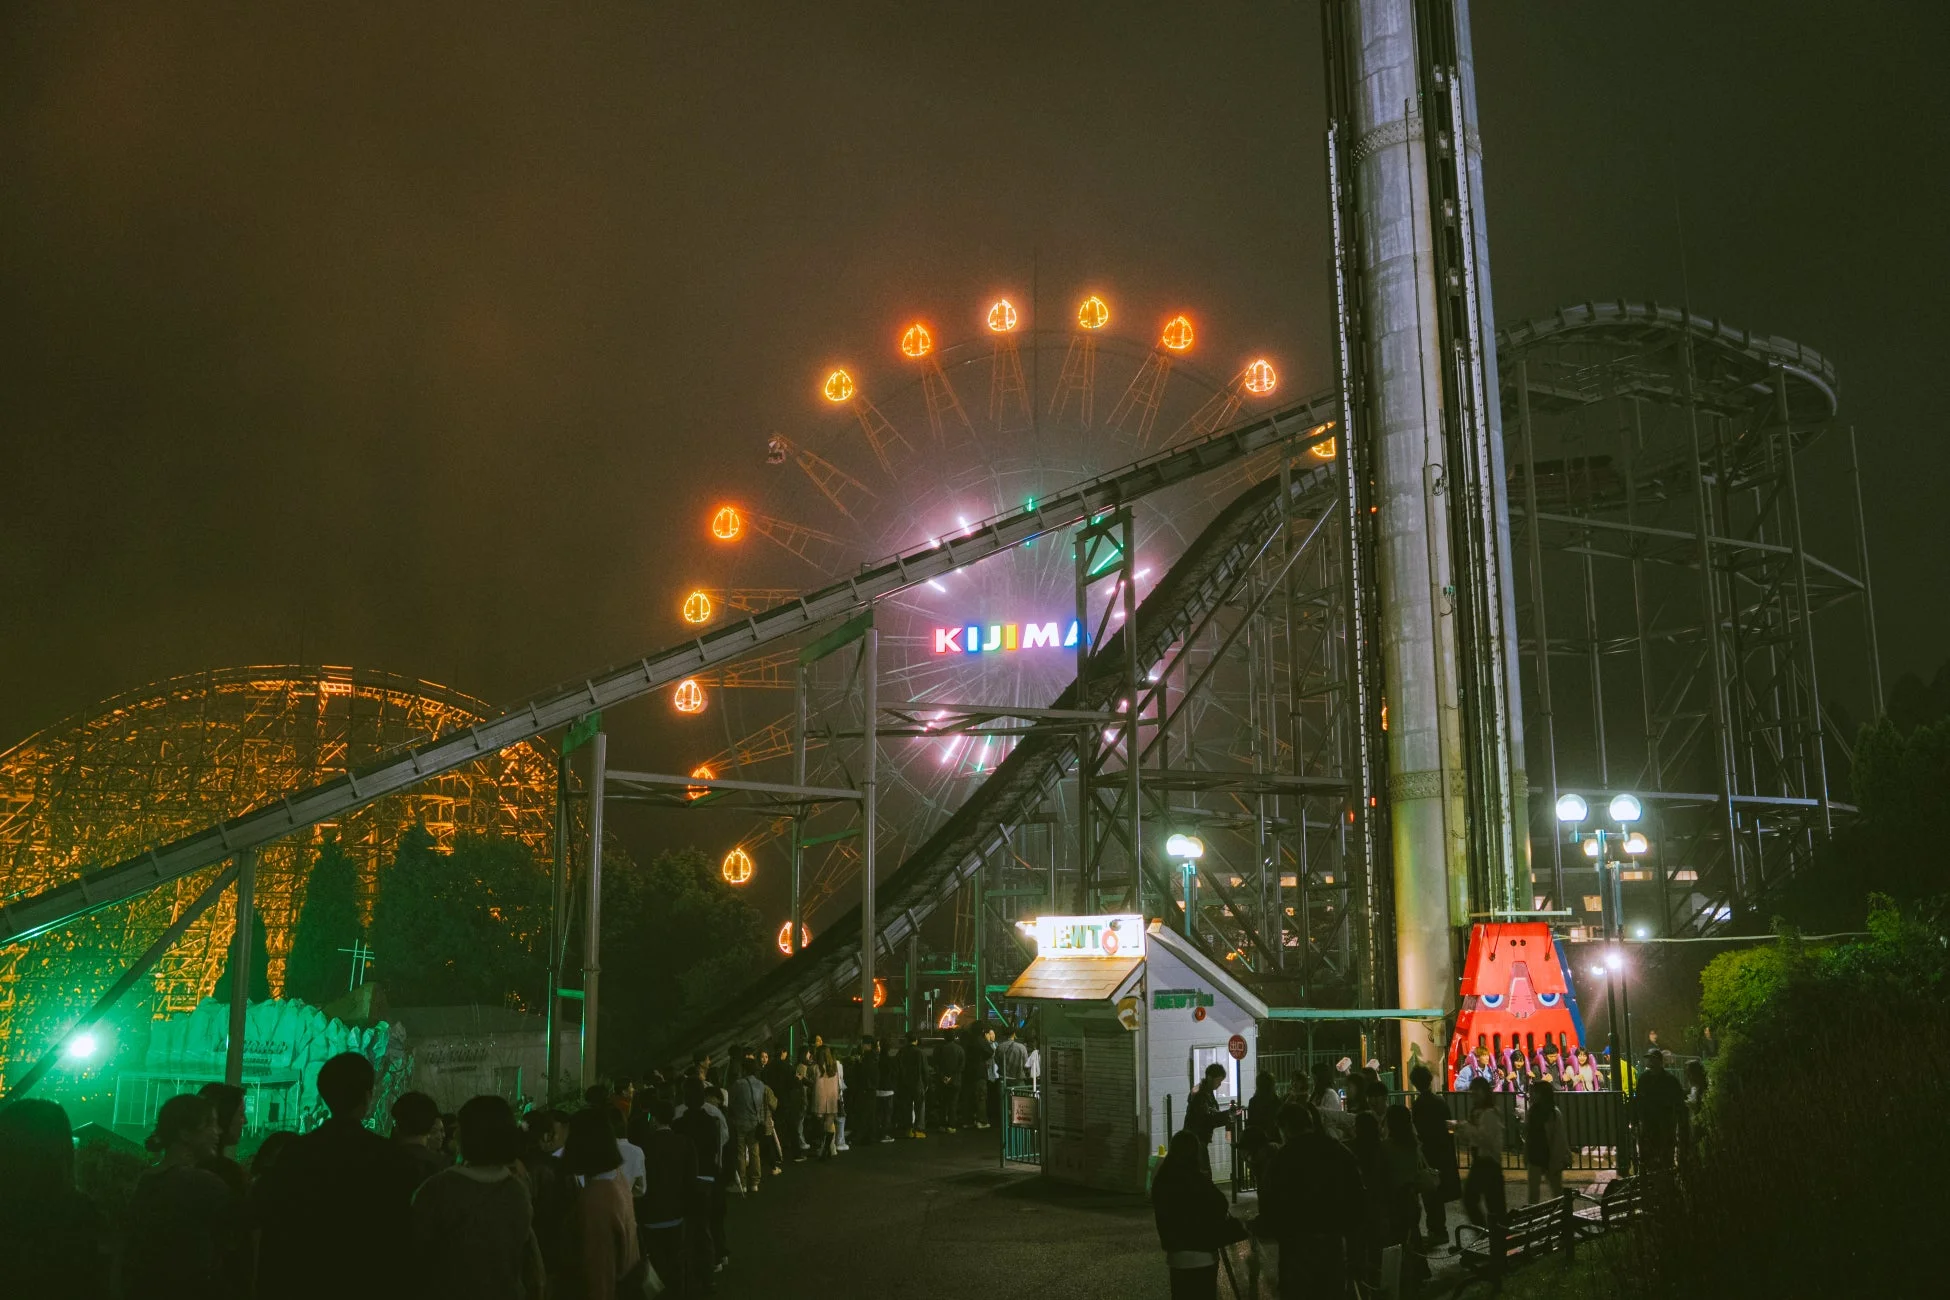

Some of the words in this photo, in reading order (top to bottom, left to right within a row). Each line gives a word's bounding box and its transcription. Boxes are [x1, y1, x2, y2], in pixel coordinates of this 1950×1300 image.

[935, 617, 1092, 653] KIJIMA
[1042, 924, 1139, 954] EWTO
[1230, 1040, 1244, 1051] 出口
